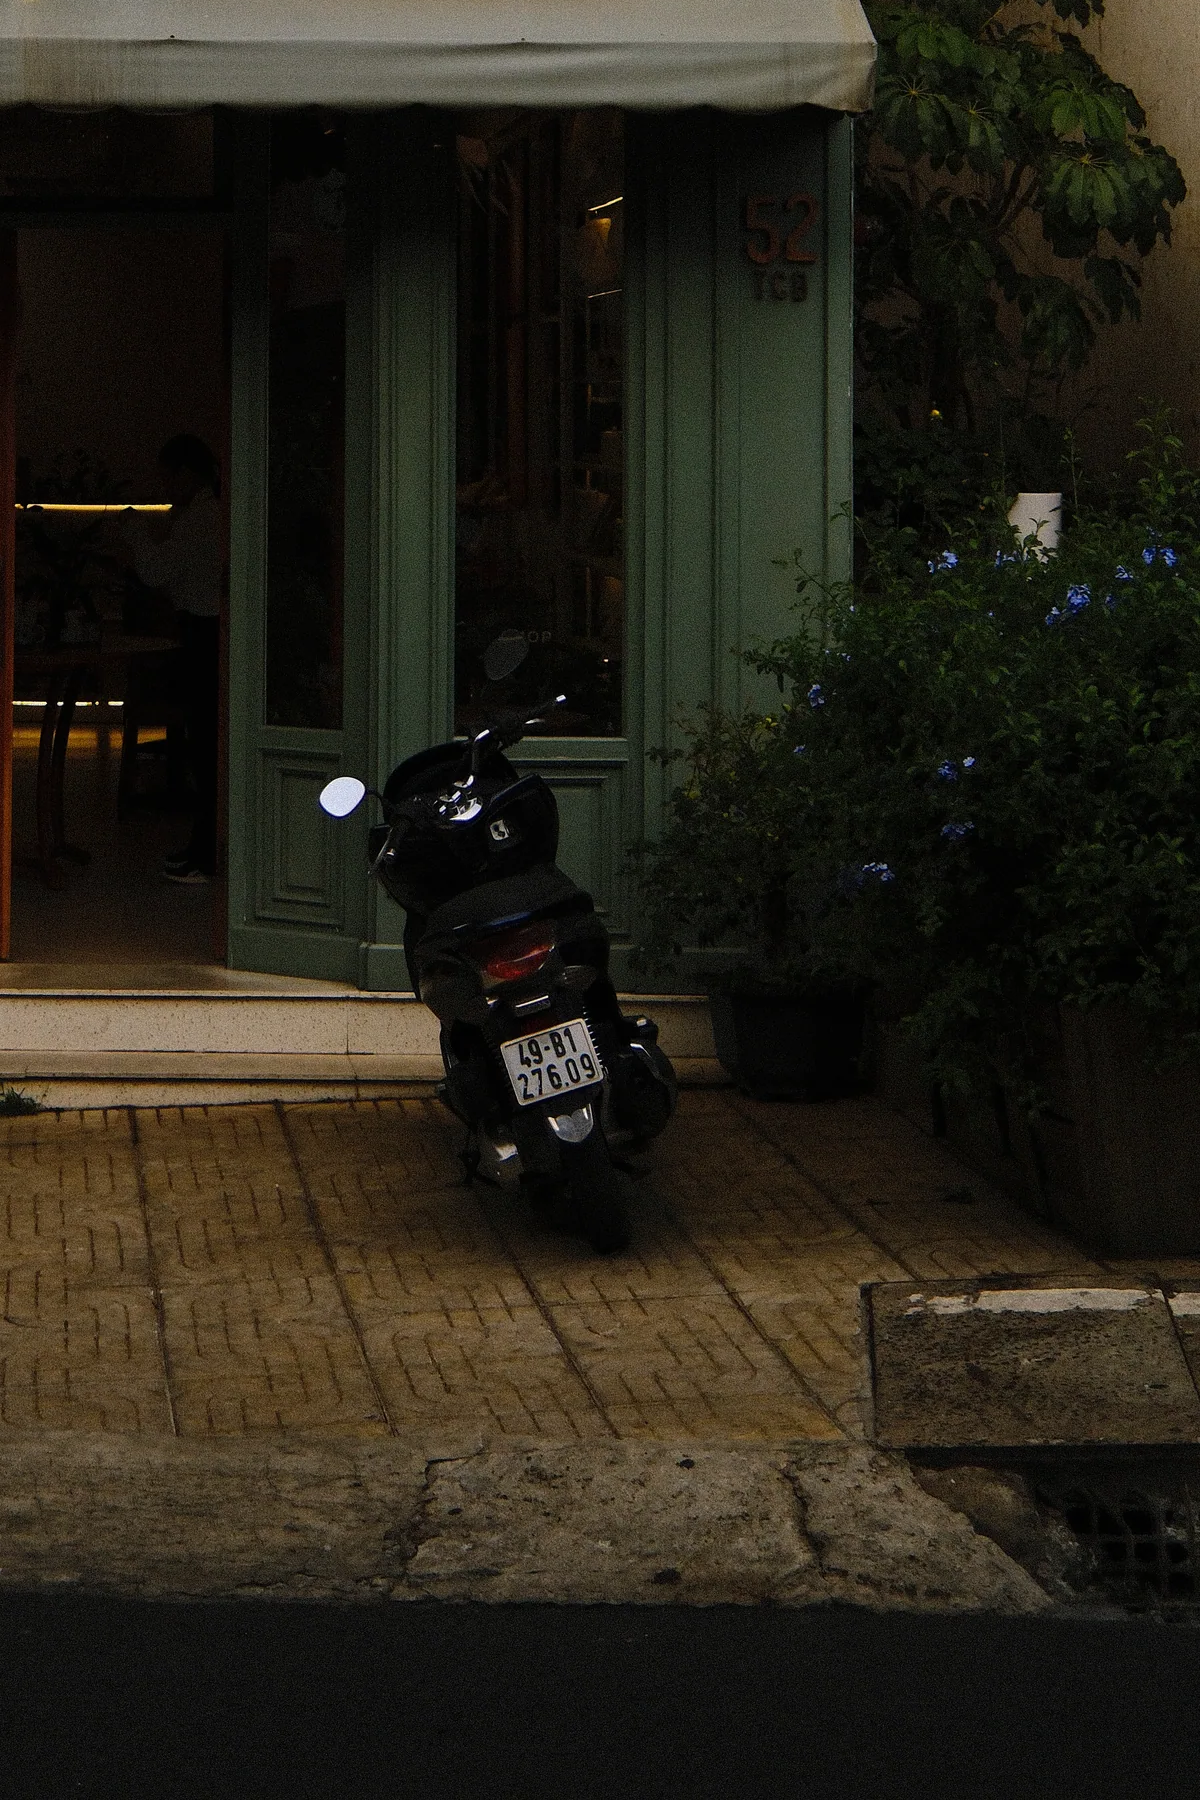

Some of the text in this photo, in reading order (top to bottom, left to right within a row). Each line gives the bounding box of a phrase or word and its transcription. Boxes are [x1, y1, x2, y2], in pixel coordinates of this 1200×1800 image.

[744, 191, 820, 266] 52
[518, 1027, 578, 1068] 49-B1
[517, 1053, 597, 1101] 276.09
